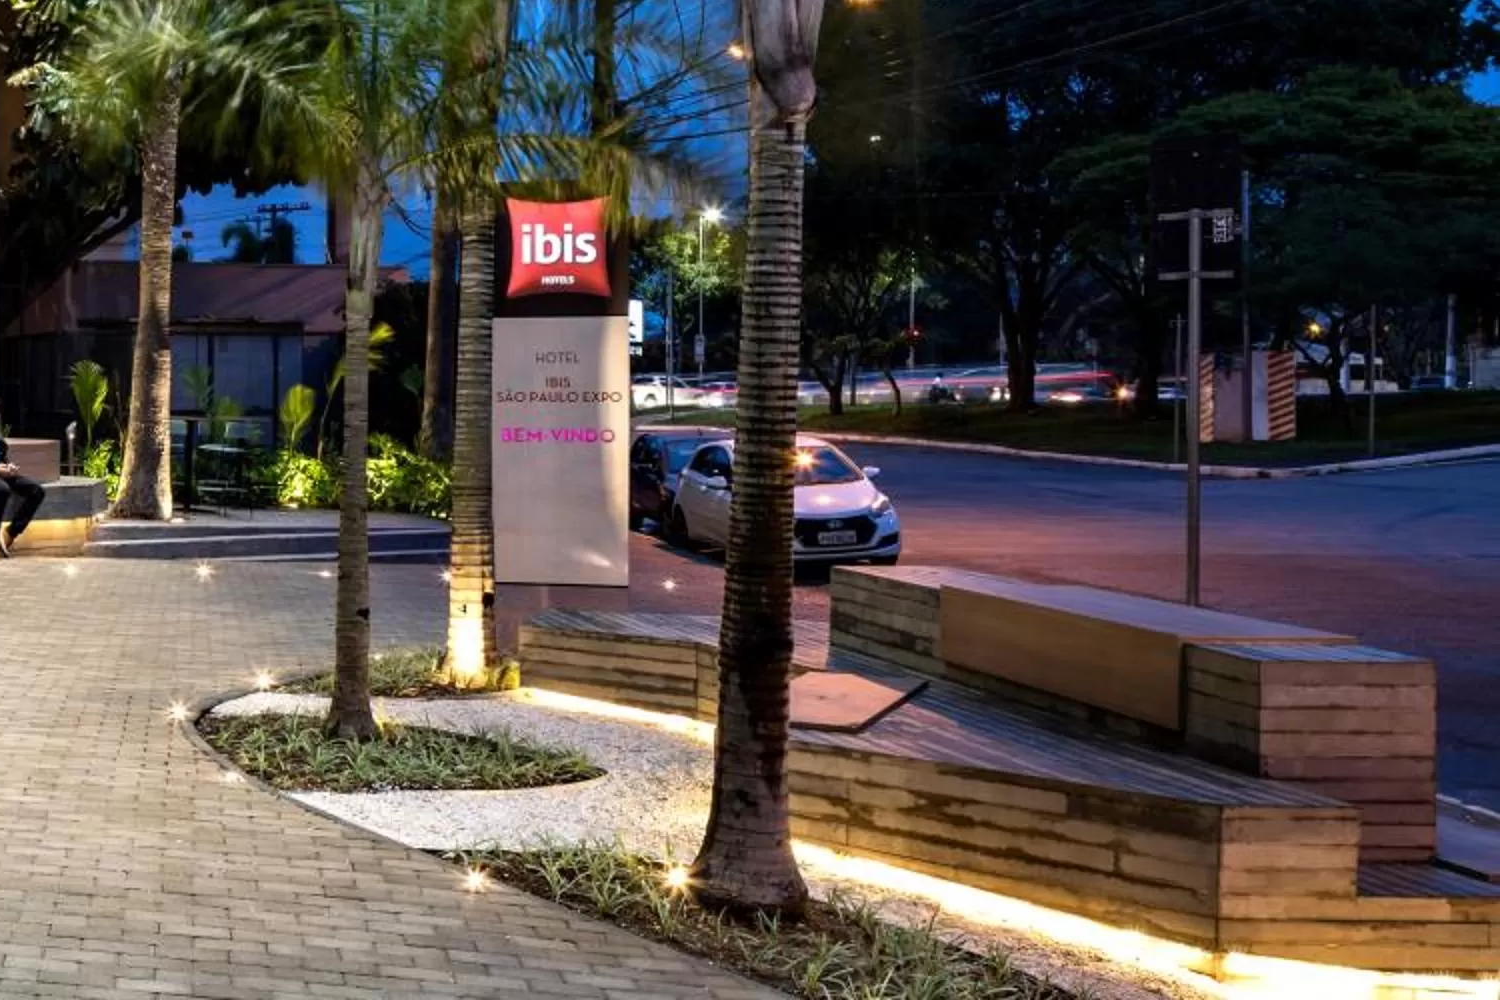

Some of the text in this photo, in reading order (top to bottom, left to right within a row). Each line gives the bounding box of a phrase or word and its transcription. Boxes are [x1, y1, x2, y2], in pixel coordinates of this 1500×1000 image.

[521, 223, 597, 265] ibis
[535, 351, 580, 364] HOTEL
[545, 376, 571, 388] IBIS
[496, 388, 623, 402] SÃO PAULO EXPO
[501, 427, 615, 442] BEM-VINDO
